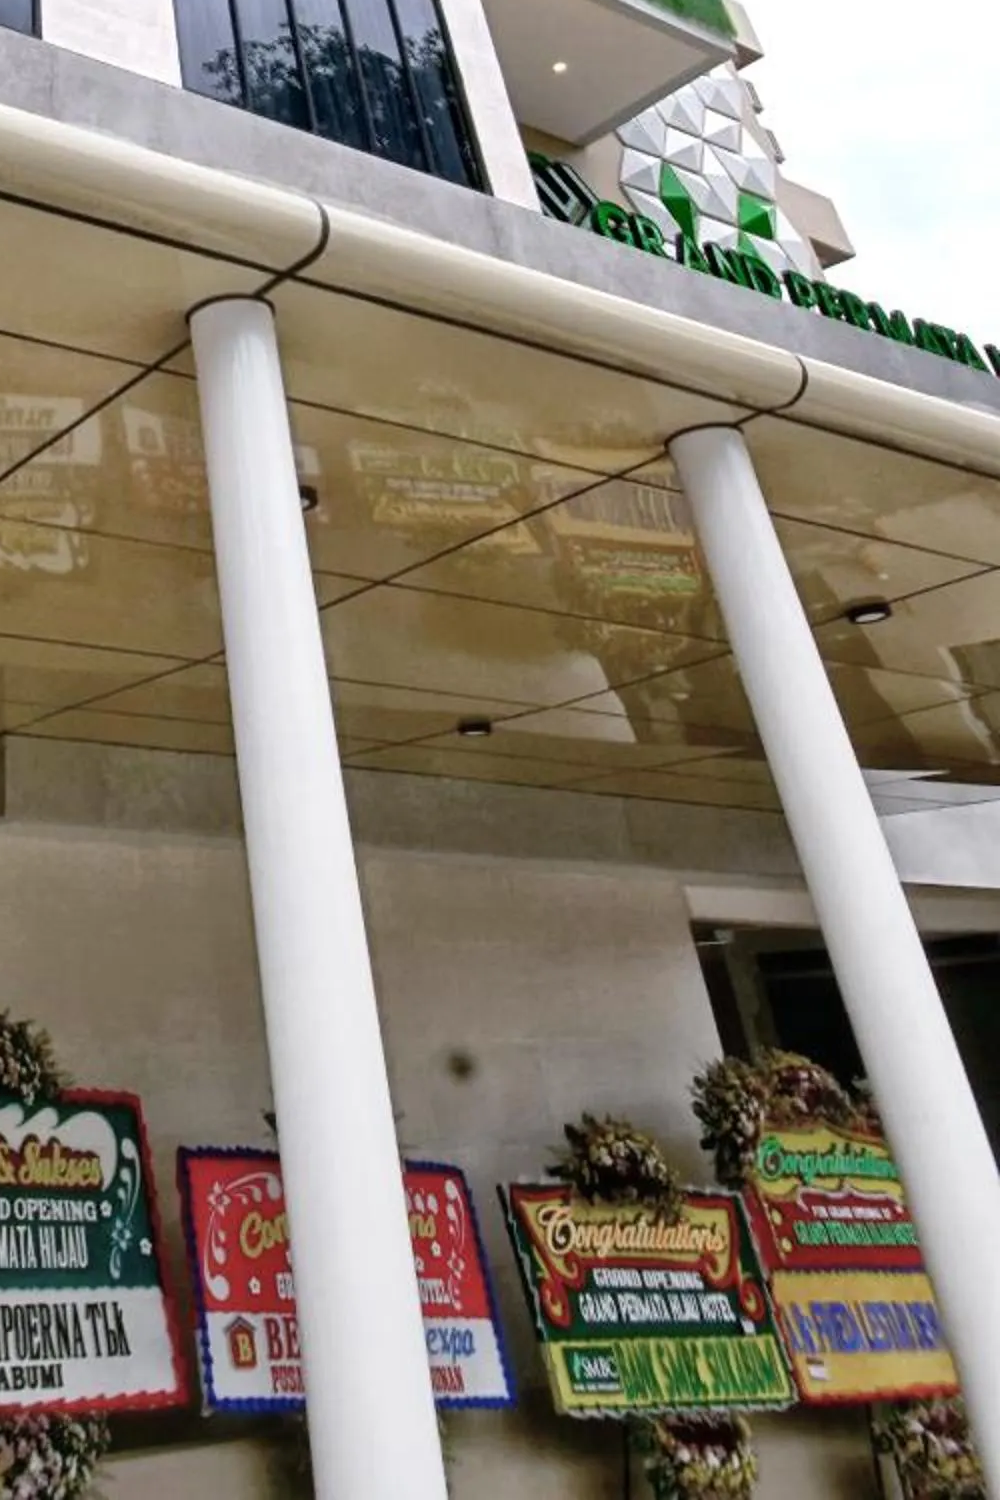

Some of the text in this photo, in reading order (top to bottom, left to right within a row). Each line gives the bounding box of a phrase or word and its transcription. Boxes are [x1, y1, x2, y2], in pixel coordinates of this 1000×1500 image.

[591, 200, 783, 301] GRAND
[19, 1137, 103, 1186] Sukses
[758, 1135, 899, 1185] Congratulation
[14, 1198, 98, 1222] OPENING
[539, 1202, 727, 1257] Congratulations
[39, 1226, 89, 1270] HIJAU
